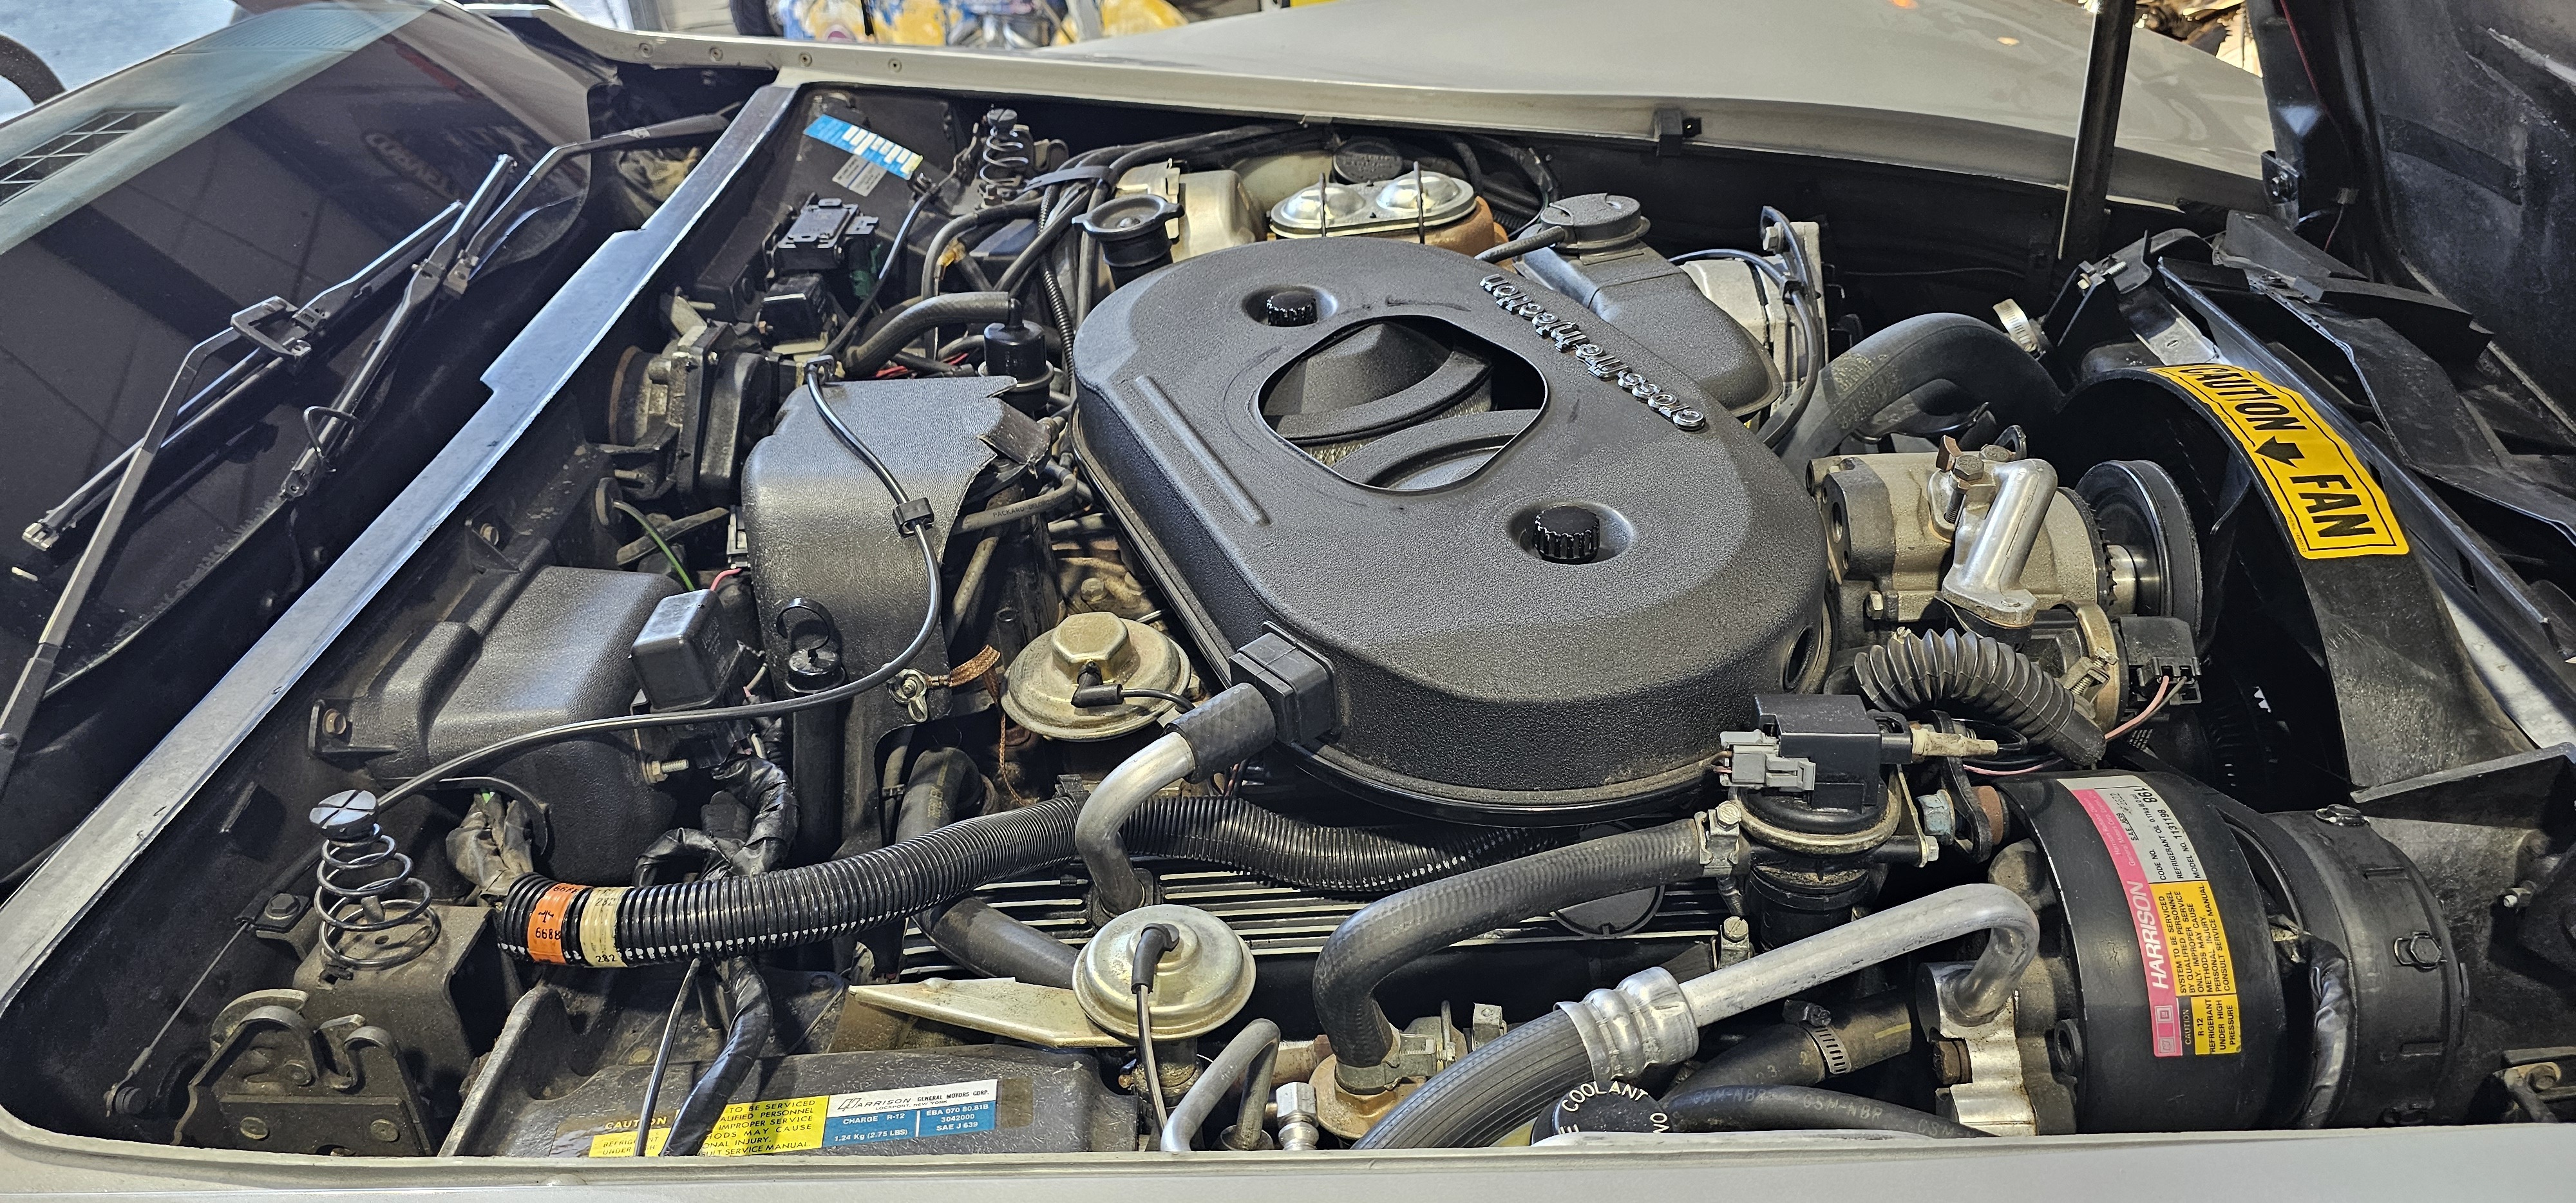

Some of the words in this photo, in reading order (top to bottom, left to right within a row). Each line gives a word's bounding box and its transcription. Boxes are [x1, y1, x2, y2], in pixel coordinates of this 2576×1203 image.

[2179, 368, 2307, 431] CAUTION
[993, 506, 1025, 518] PACKARD
[2289, 475, 2376, 538] FAN
[2134, 788, 2157, 803] 198
[2157, 809, 2183, 840] 1131198
[2121, 844, 2136, 866] General
[2159, 835, 2184, 879] REFRIGERANT
[2186, 855, 2201, 878] MODEL
[2154, 862, 2166, 880] CODE
[2174, 891, 2189, 922] SERVICE
[2199, 883, 2213, 916] MANUAL.
[2159, 896, 2174, 933] SERVICED
[2166, 891, 2183, 934] PERSONNEL
[2187, 903, 2199, 929] CAUSE
[2127, 881, 2168, 989] HARRISON
[2170, 936, 2177, 945] BE
[2186, 927, 2200, 966] IMPROPER
[2210, 919, 2222, 951] SERVICE
[596, 954, 616, 963] 282
[2173, 948, 2180, 959] TO
[2180, 938, 2193, 980] QUALIFIED
[2175, 961, 2186, 993] SYSTEM
[2195, 971, 2204, 992] ONLY.
[2202, 953, 2213, 992] METHODS
[2210, 950, 2222, 992] PERSONAL
[2219, 955, 2230, 991] CONSULT
[2187, 983, 2195, 993] BY
[2215, 999, 2224, 1019] HIGH
[2183, 1009, 2192, 1045] CAUTION
[2205, 999, 2215, 1052] REFRIGERANT
[2218, 1023, 2226, 1050] UNDER
[2226, 1005, 2236, 1045] PRESSURE
[765, 1100, 815, 1110] SERVICED
[1561, 1081, 1649, 1112] COOLANT
[605, 1116, 667, 1129] CAUTON
[719, 1113, 753, 1122] ALIFIED
[761, 1108, 814, 1118] PERSONNEL
[719, 1121, 766, 1130] IMPROPER
[770, 1115, 813, 1125] SERVICE
[843, 1115, 878, 1124] CHARGE
[942, 1113, 975, 1122] 3042000
[603, 1136, 659, 1148] REFRIGNT
[735, 1137, 772, 1146] INJURY.
[744, 1128, 769, 1136] MAY
[776, 1124, 812, 1133] CAUSE
[603, 1146, 631, 1155] UNDER
[725, 1145, 764, 1156] SERVICE
[765, 1142, 811, 1151] MANUAL.
